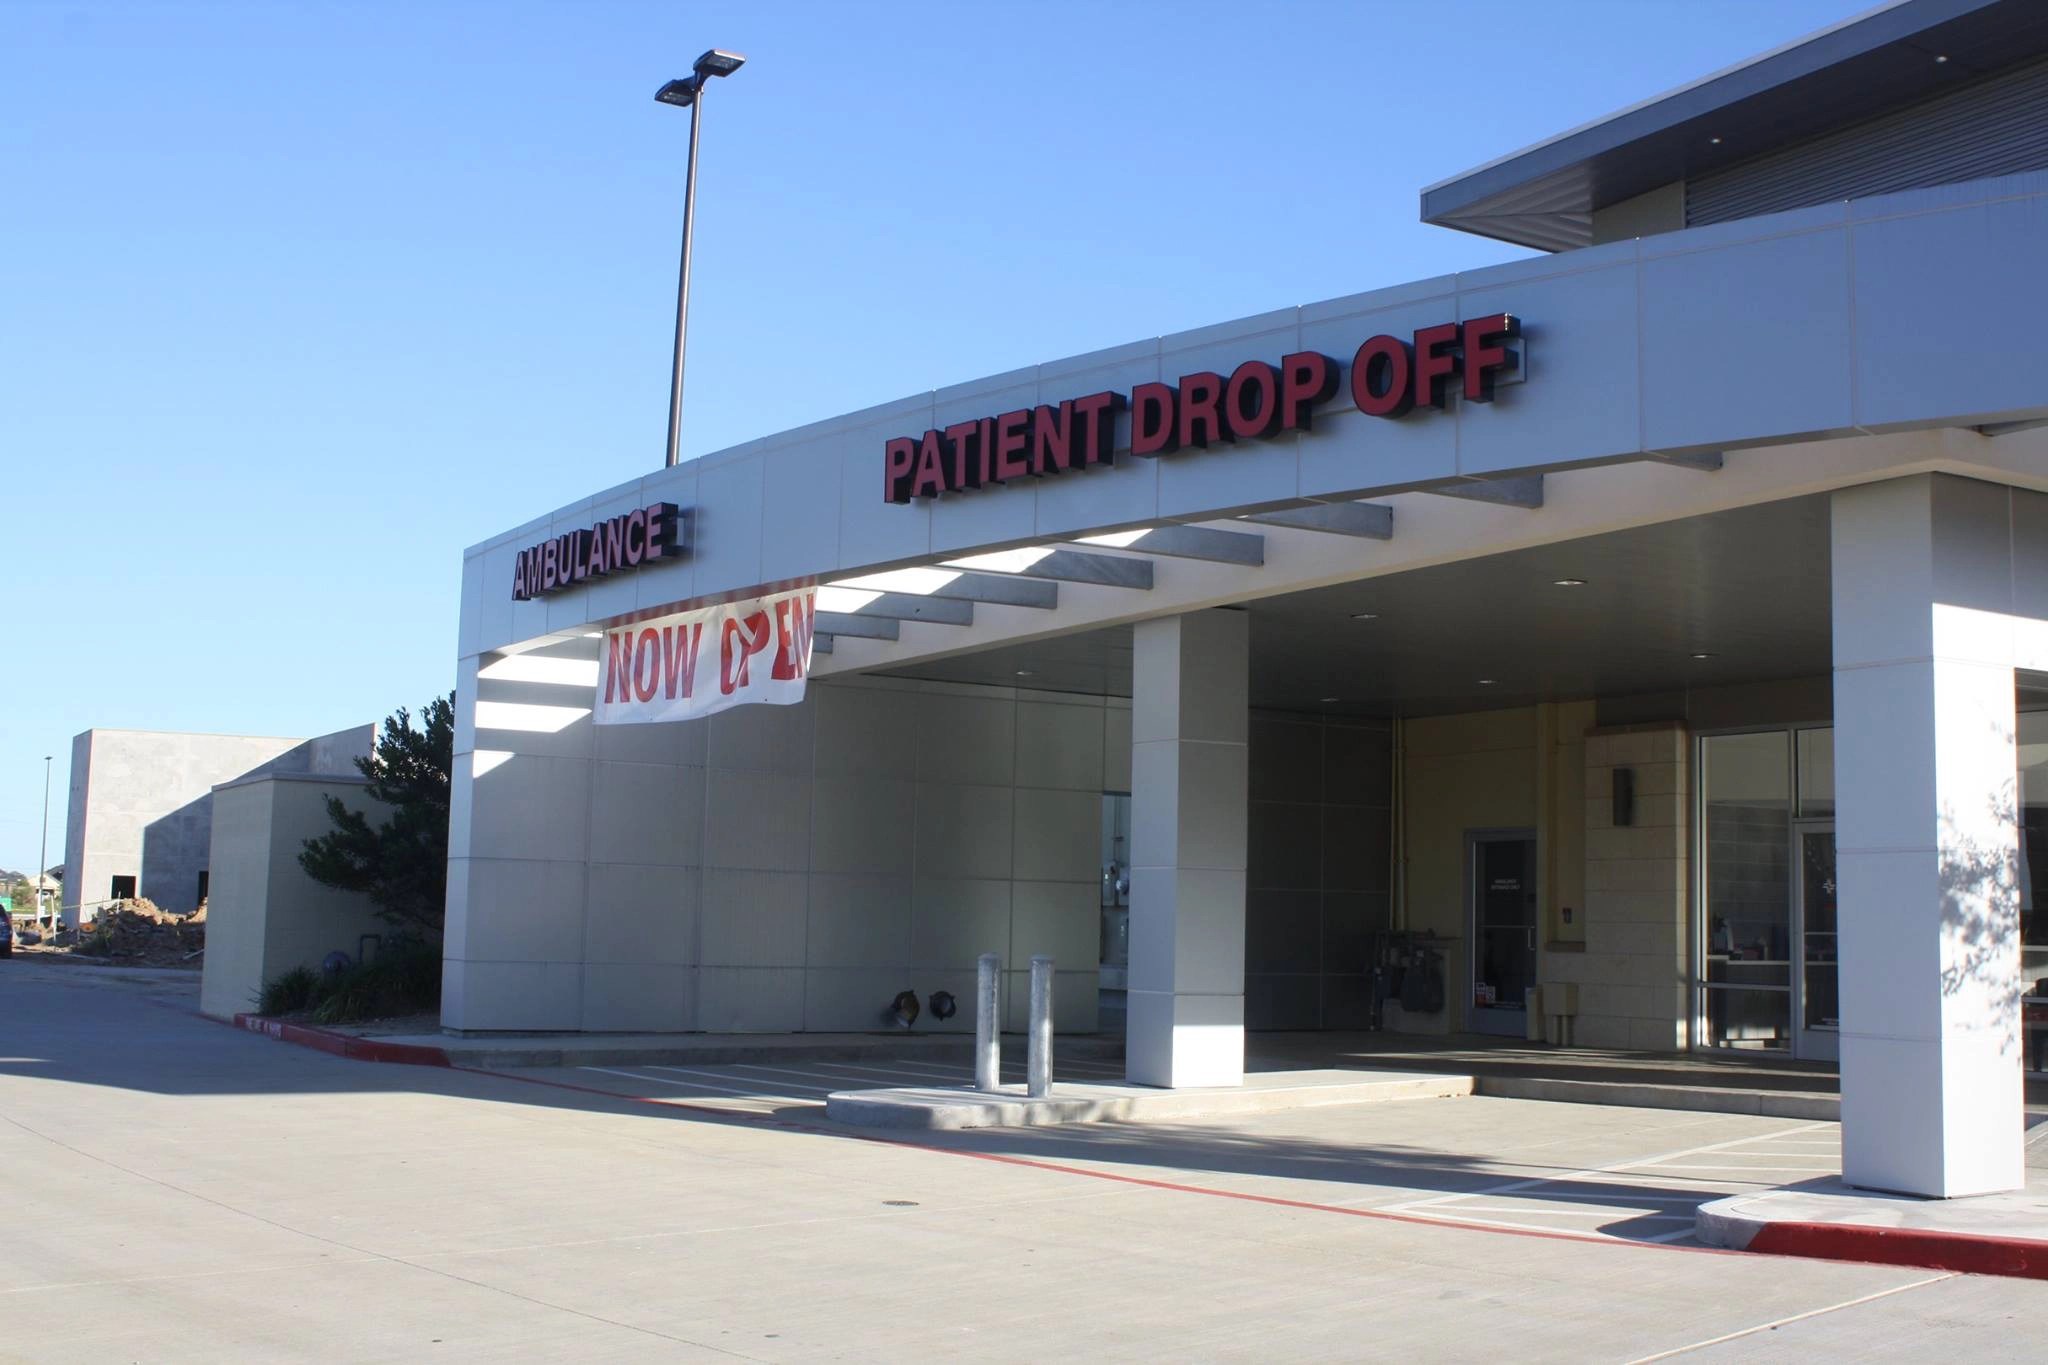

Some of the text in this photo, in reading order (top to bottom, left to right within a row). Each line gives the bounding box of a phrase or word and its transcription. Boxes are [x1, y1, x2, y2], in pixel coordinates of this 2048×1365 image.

[885, 313, 1508, 503] PATIENT DROP OFF
[512, 502, 665, 600] AMBULANCE
[604, 593, 815, 704] NOW OPEN
